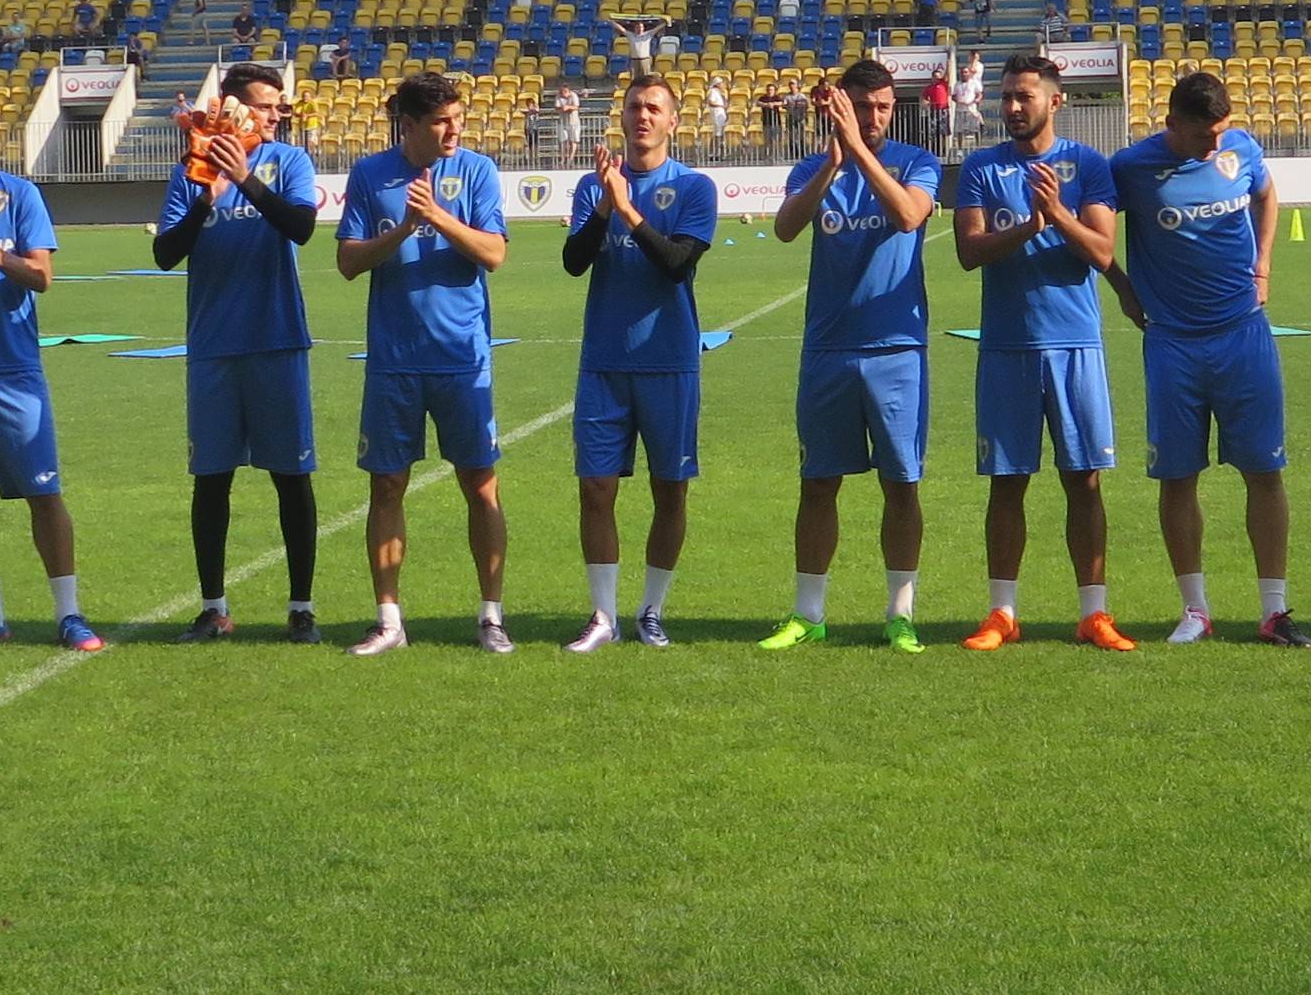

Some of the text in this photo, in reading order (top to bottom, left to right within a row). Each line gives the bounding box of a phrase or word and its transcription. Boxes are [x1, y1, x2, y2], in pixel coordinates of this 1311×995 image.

[901, 61, 946, 72] VEOLIA
[1071, 58, 1115, 68] VEOLIA
[742, 185, 787, 196] VEOLIA
[1184, 193, 1251, 221] VEOLIA
[221, 205, 262, 221] VEO
